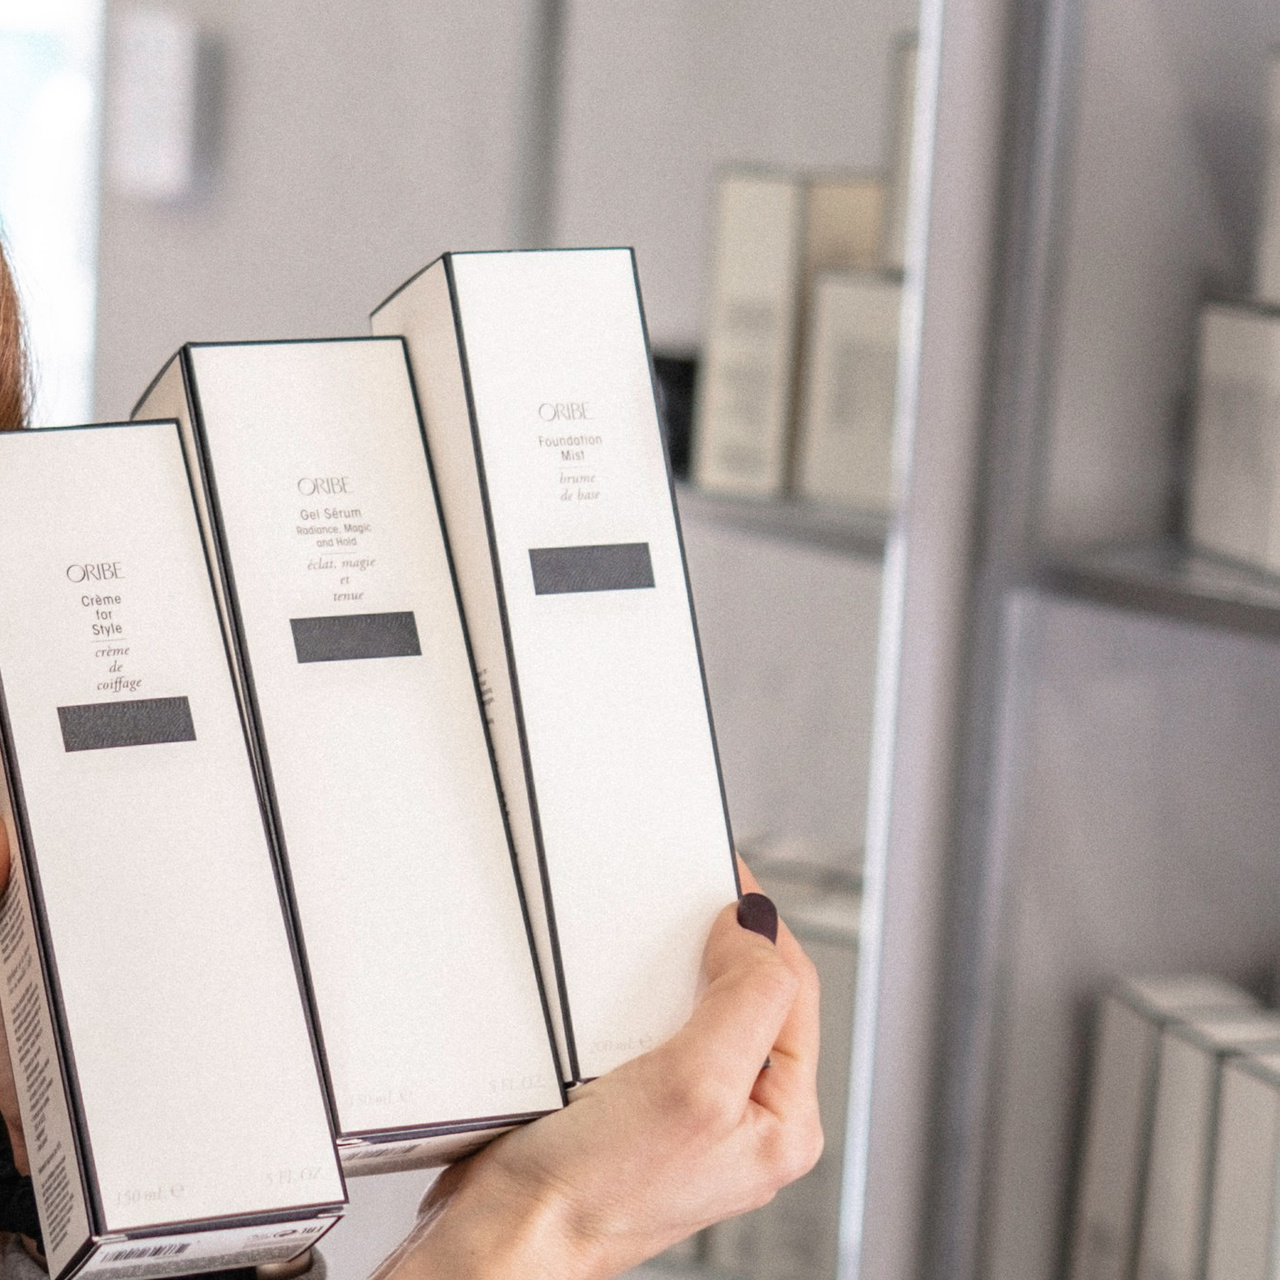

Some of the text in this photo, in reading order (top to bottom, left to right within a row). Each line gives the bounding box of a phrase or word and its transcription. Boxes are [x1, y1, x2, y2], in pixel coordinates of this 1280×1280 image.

[538, 402, 594, 422] ORIBE
[538, 435, 603, 448] Foundation
[561, 450, 585, 462] Mist
[559, 473, 596, 485] brume
[297, 476, 354, 496] ORIBE
[561, 489, 601, 502] de base
[300, 507, 362, 521] Gel Sérum
[344, 523, 372, 535] Magic
[316, 536, 358, 548] and Hold
[342, 558, 377, 572] magie
[66, 561, 127, 583] ORIBE
[340, 575, 350, 585] et
[81, 593, 122, 608] Crème
[333, 591, 365, 602] tenue
[95, 608, 113, 621] for
[91, 622, 123, 637] Style
[95, 645, 131, 658] crème
[109, 660, 123, 673] de
[97, 677, 143, 693] coiffage
